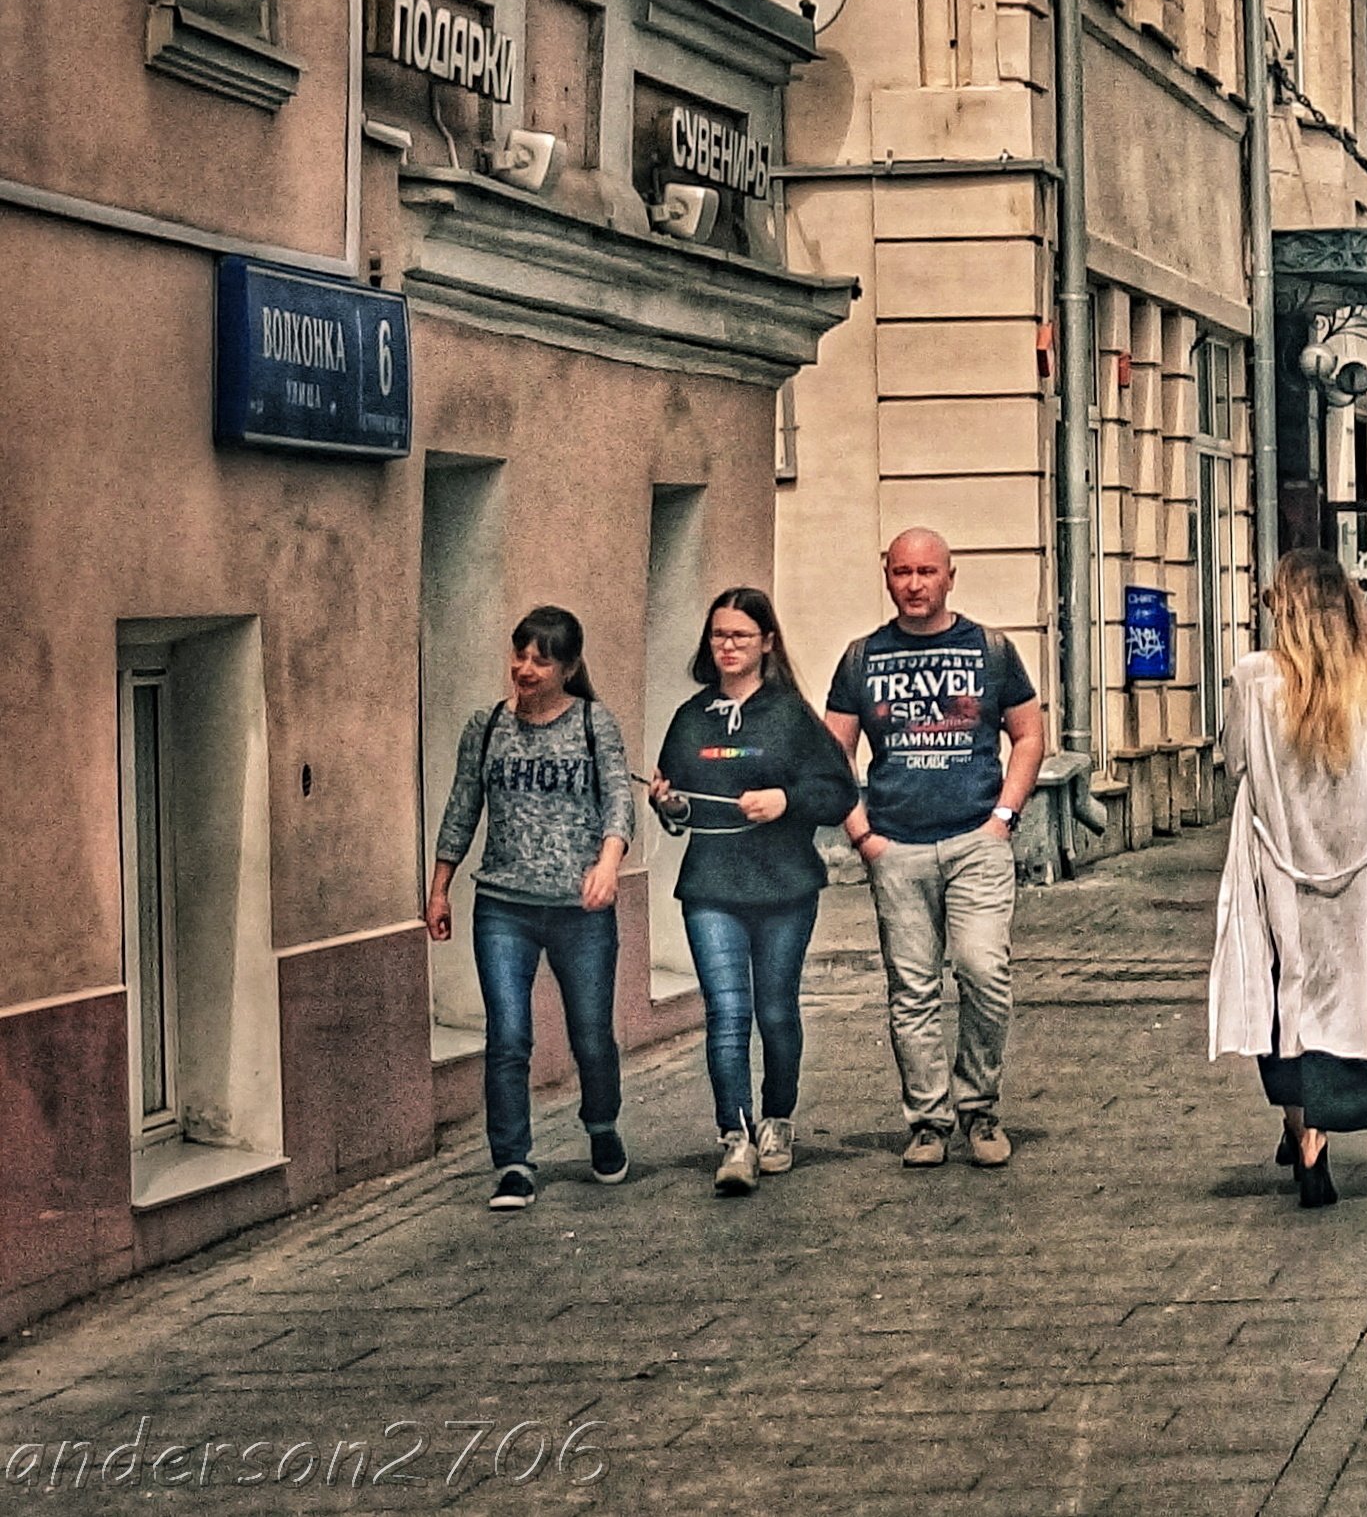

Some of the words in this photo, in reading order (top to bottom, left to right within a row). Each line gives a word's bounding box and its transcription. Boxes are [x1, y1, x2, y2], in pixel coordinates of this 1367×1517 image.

[671, 105, 773, 200] СУВЕНИРЫ
[261, 306, 347, 373] ВОЛХОНКА
[378, 318, 394, 397] 6
[866, 669, 985, 703] TRAVEL
[890, 700, 945, 723] SEA
